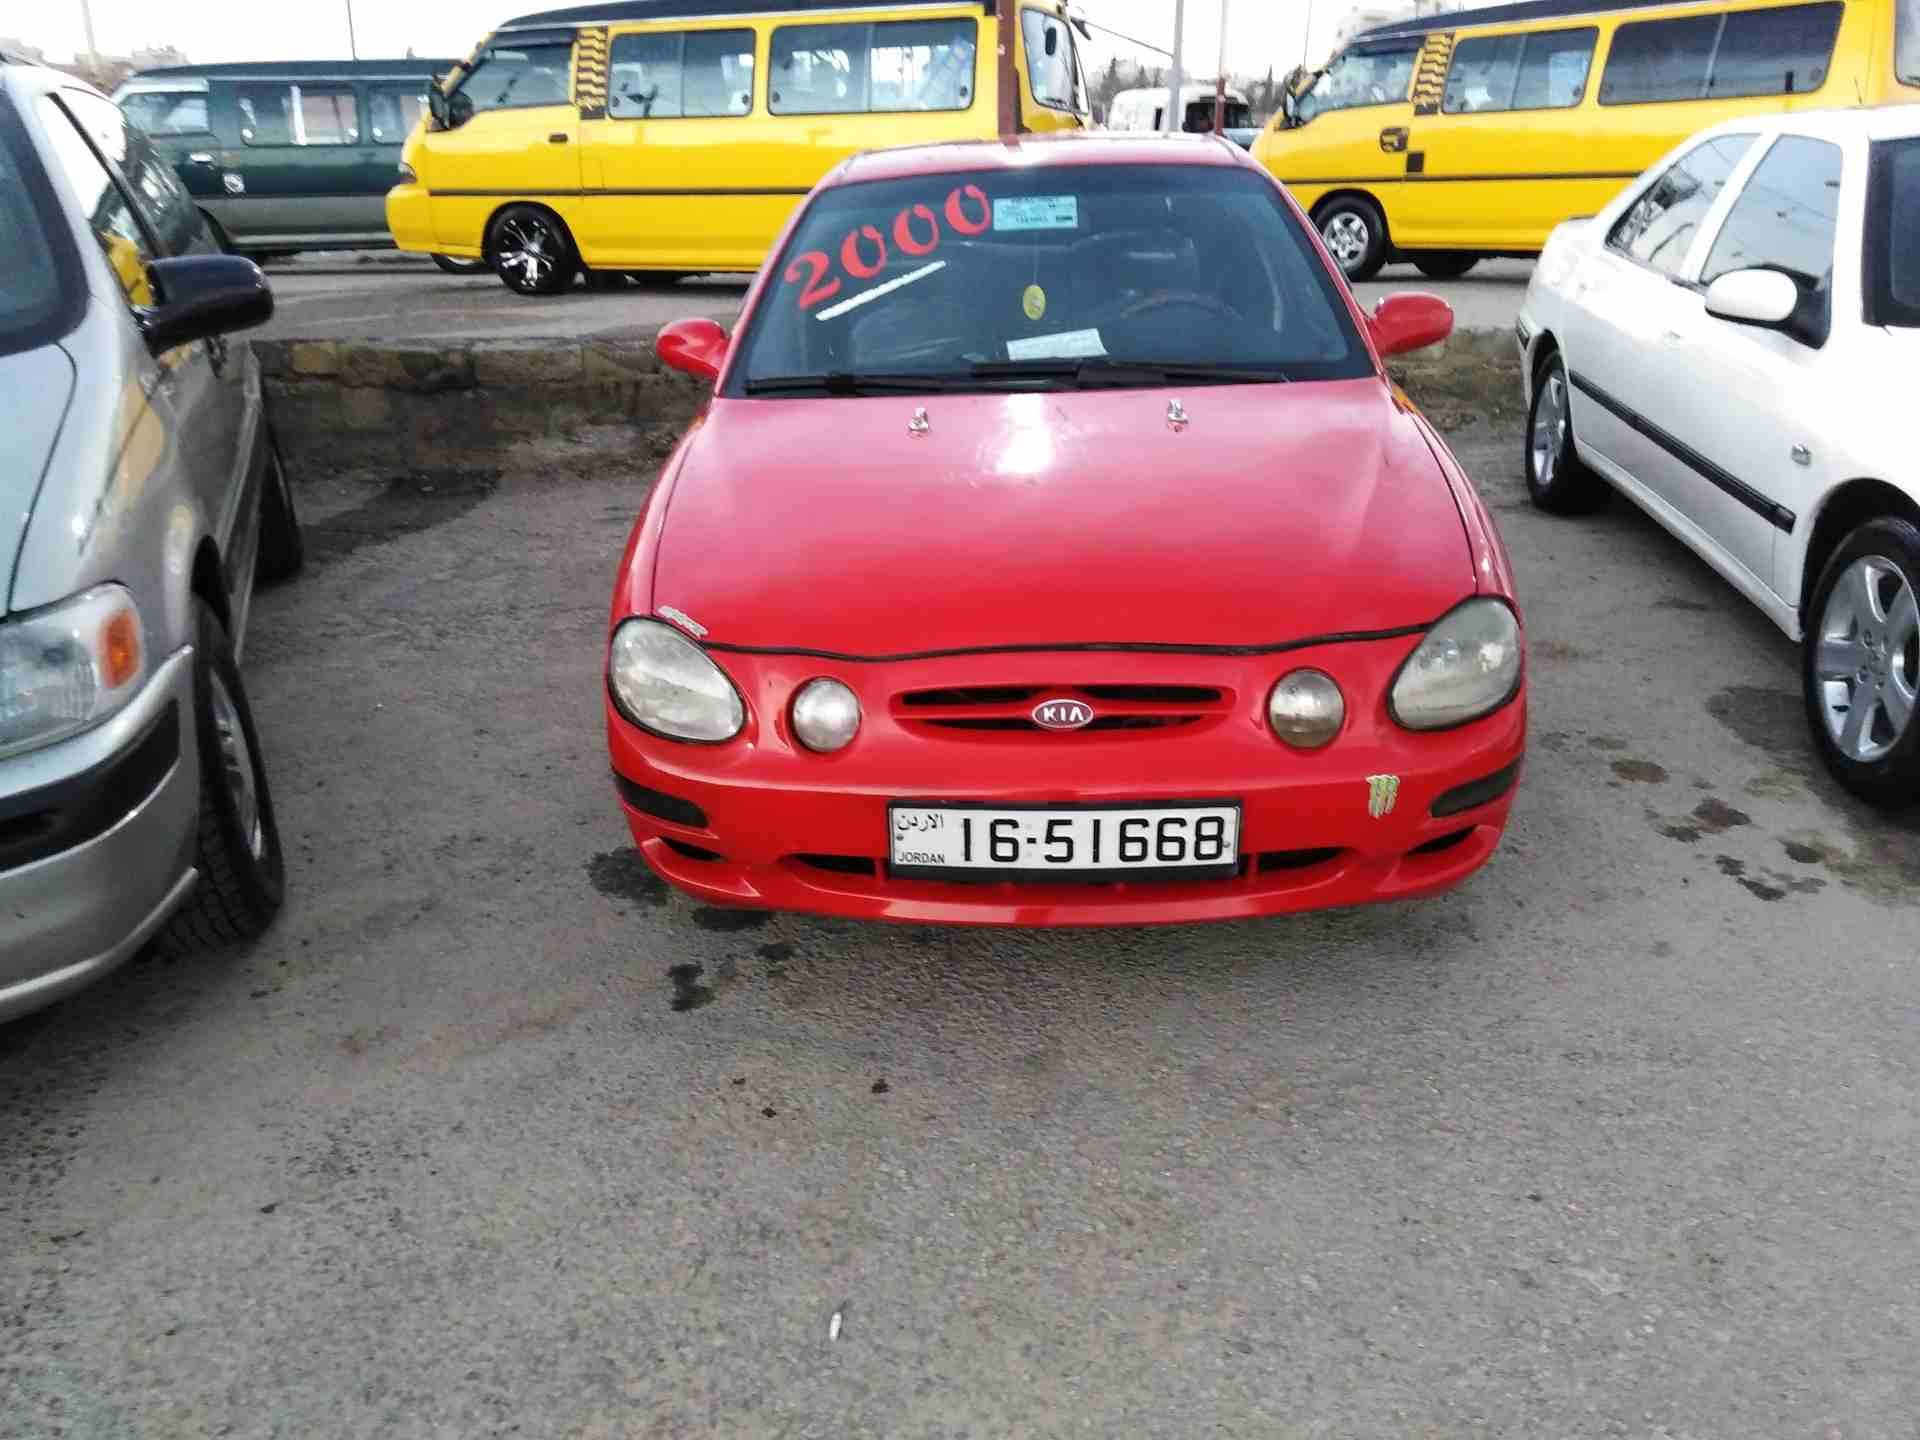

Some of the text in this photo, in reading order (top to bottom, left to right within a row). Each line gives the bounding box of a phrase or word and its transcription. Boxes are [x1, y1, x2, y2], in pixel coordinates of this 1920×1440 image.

[784, 184, 991, 310] 2000
[1043, 706, 1084, 721] KIA
[962, 816, 1225, 863] 16-51668
[898, 851, 945, 864] JORDAN
